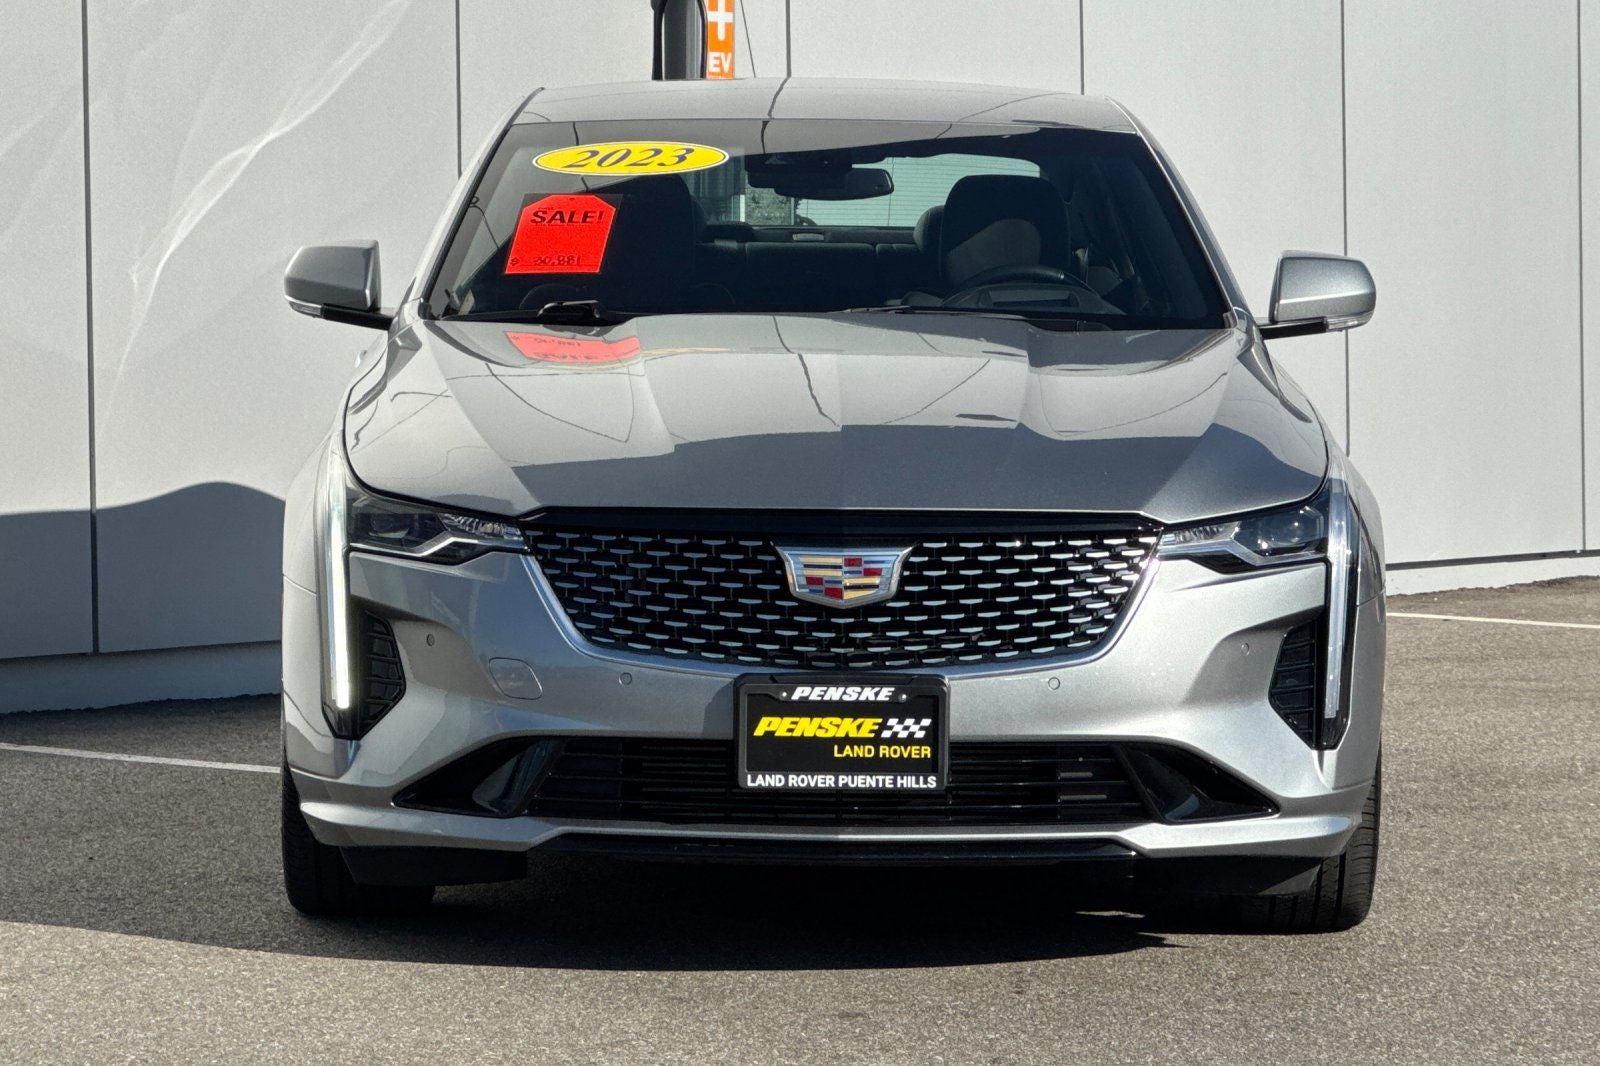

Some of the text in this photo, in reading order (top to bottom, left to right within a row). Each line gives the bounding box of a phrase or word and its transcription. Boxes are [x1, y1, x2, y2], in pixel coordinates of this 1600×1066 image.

[708, 52, 732, 73] EV
[563, 147, 695, 169] 2023
[530, 210, 604, 224] SALE!
[791, 686, 895, 701] PENSKE
[753, 716, 883, 738] PENSKE
[834, 745, 931, 758] LAND ROVER
[747, 774, 937, 789] LAND ROVER PUENTE HILLS
